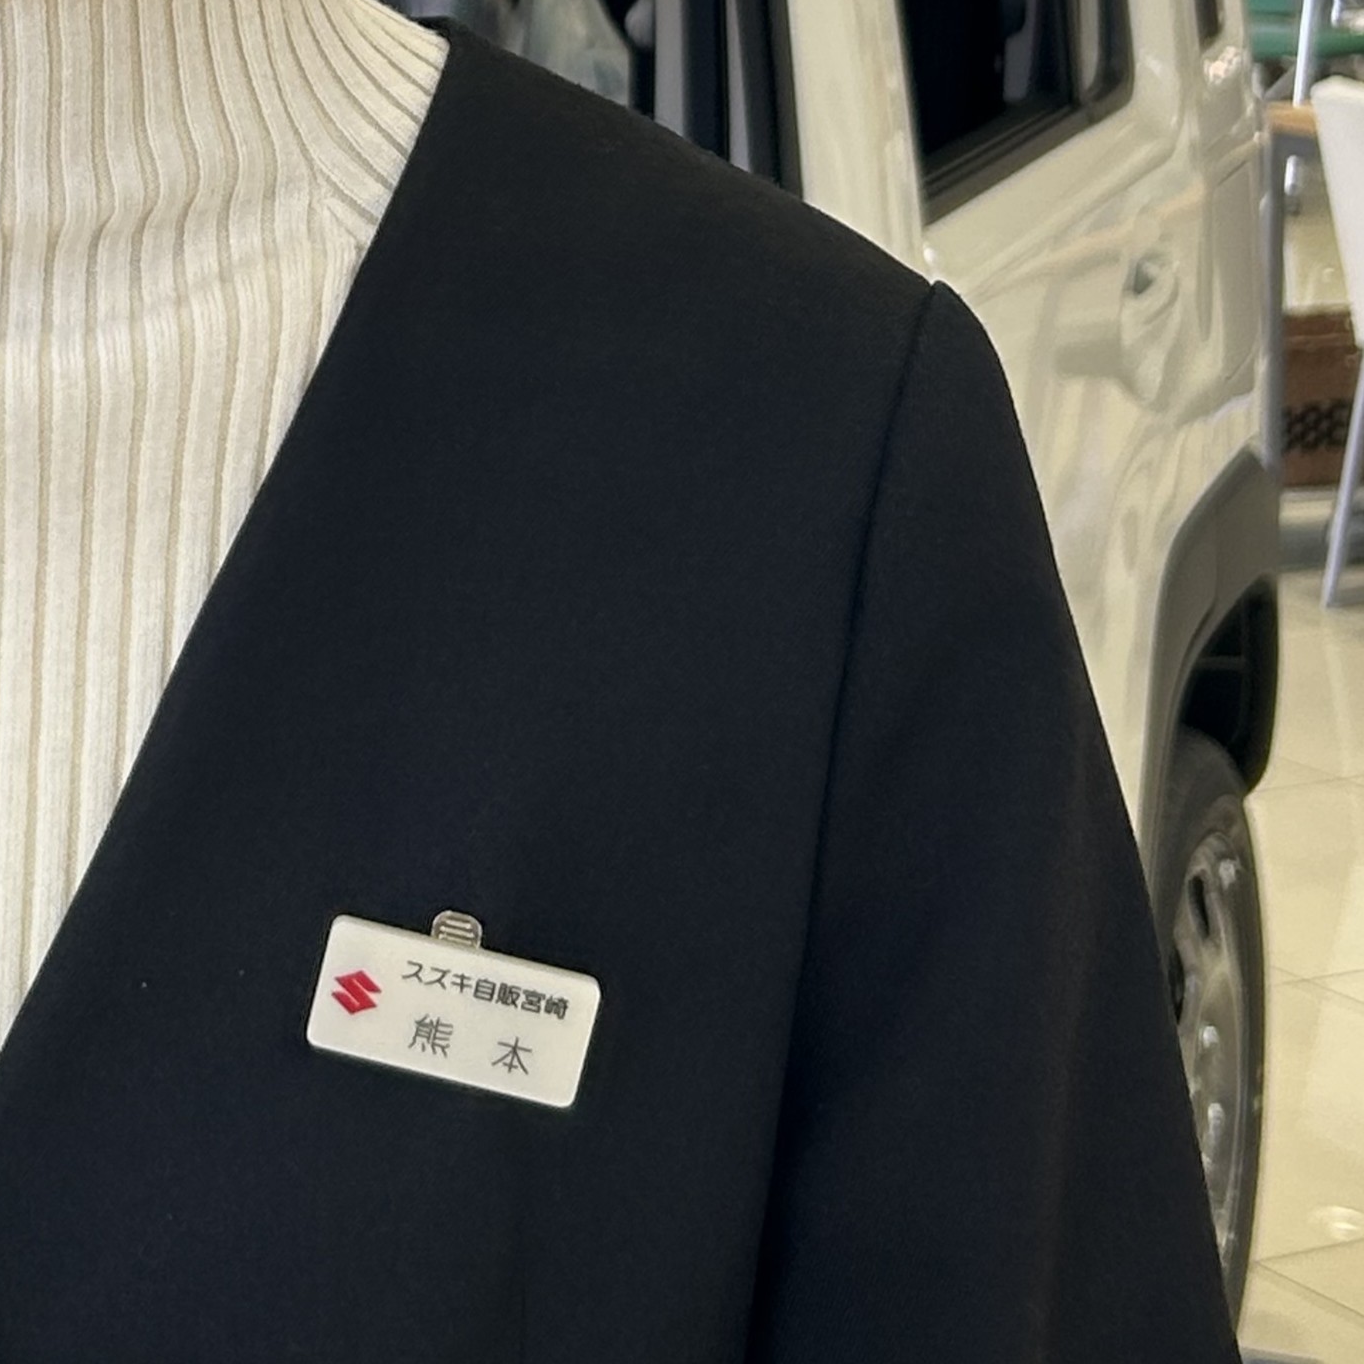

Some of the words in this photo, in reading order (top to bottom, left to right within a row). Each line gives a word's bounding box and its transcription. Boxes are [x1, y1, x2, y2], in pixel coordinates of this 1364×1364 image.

[401, 959, 570, 1020] スズキ自販宮崎
